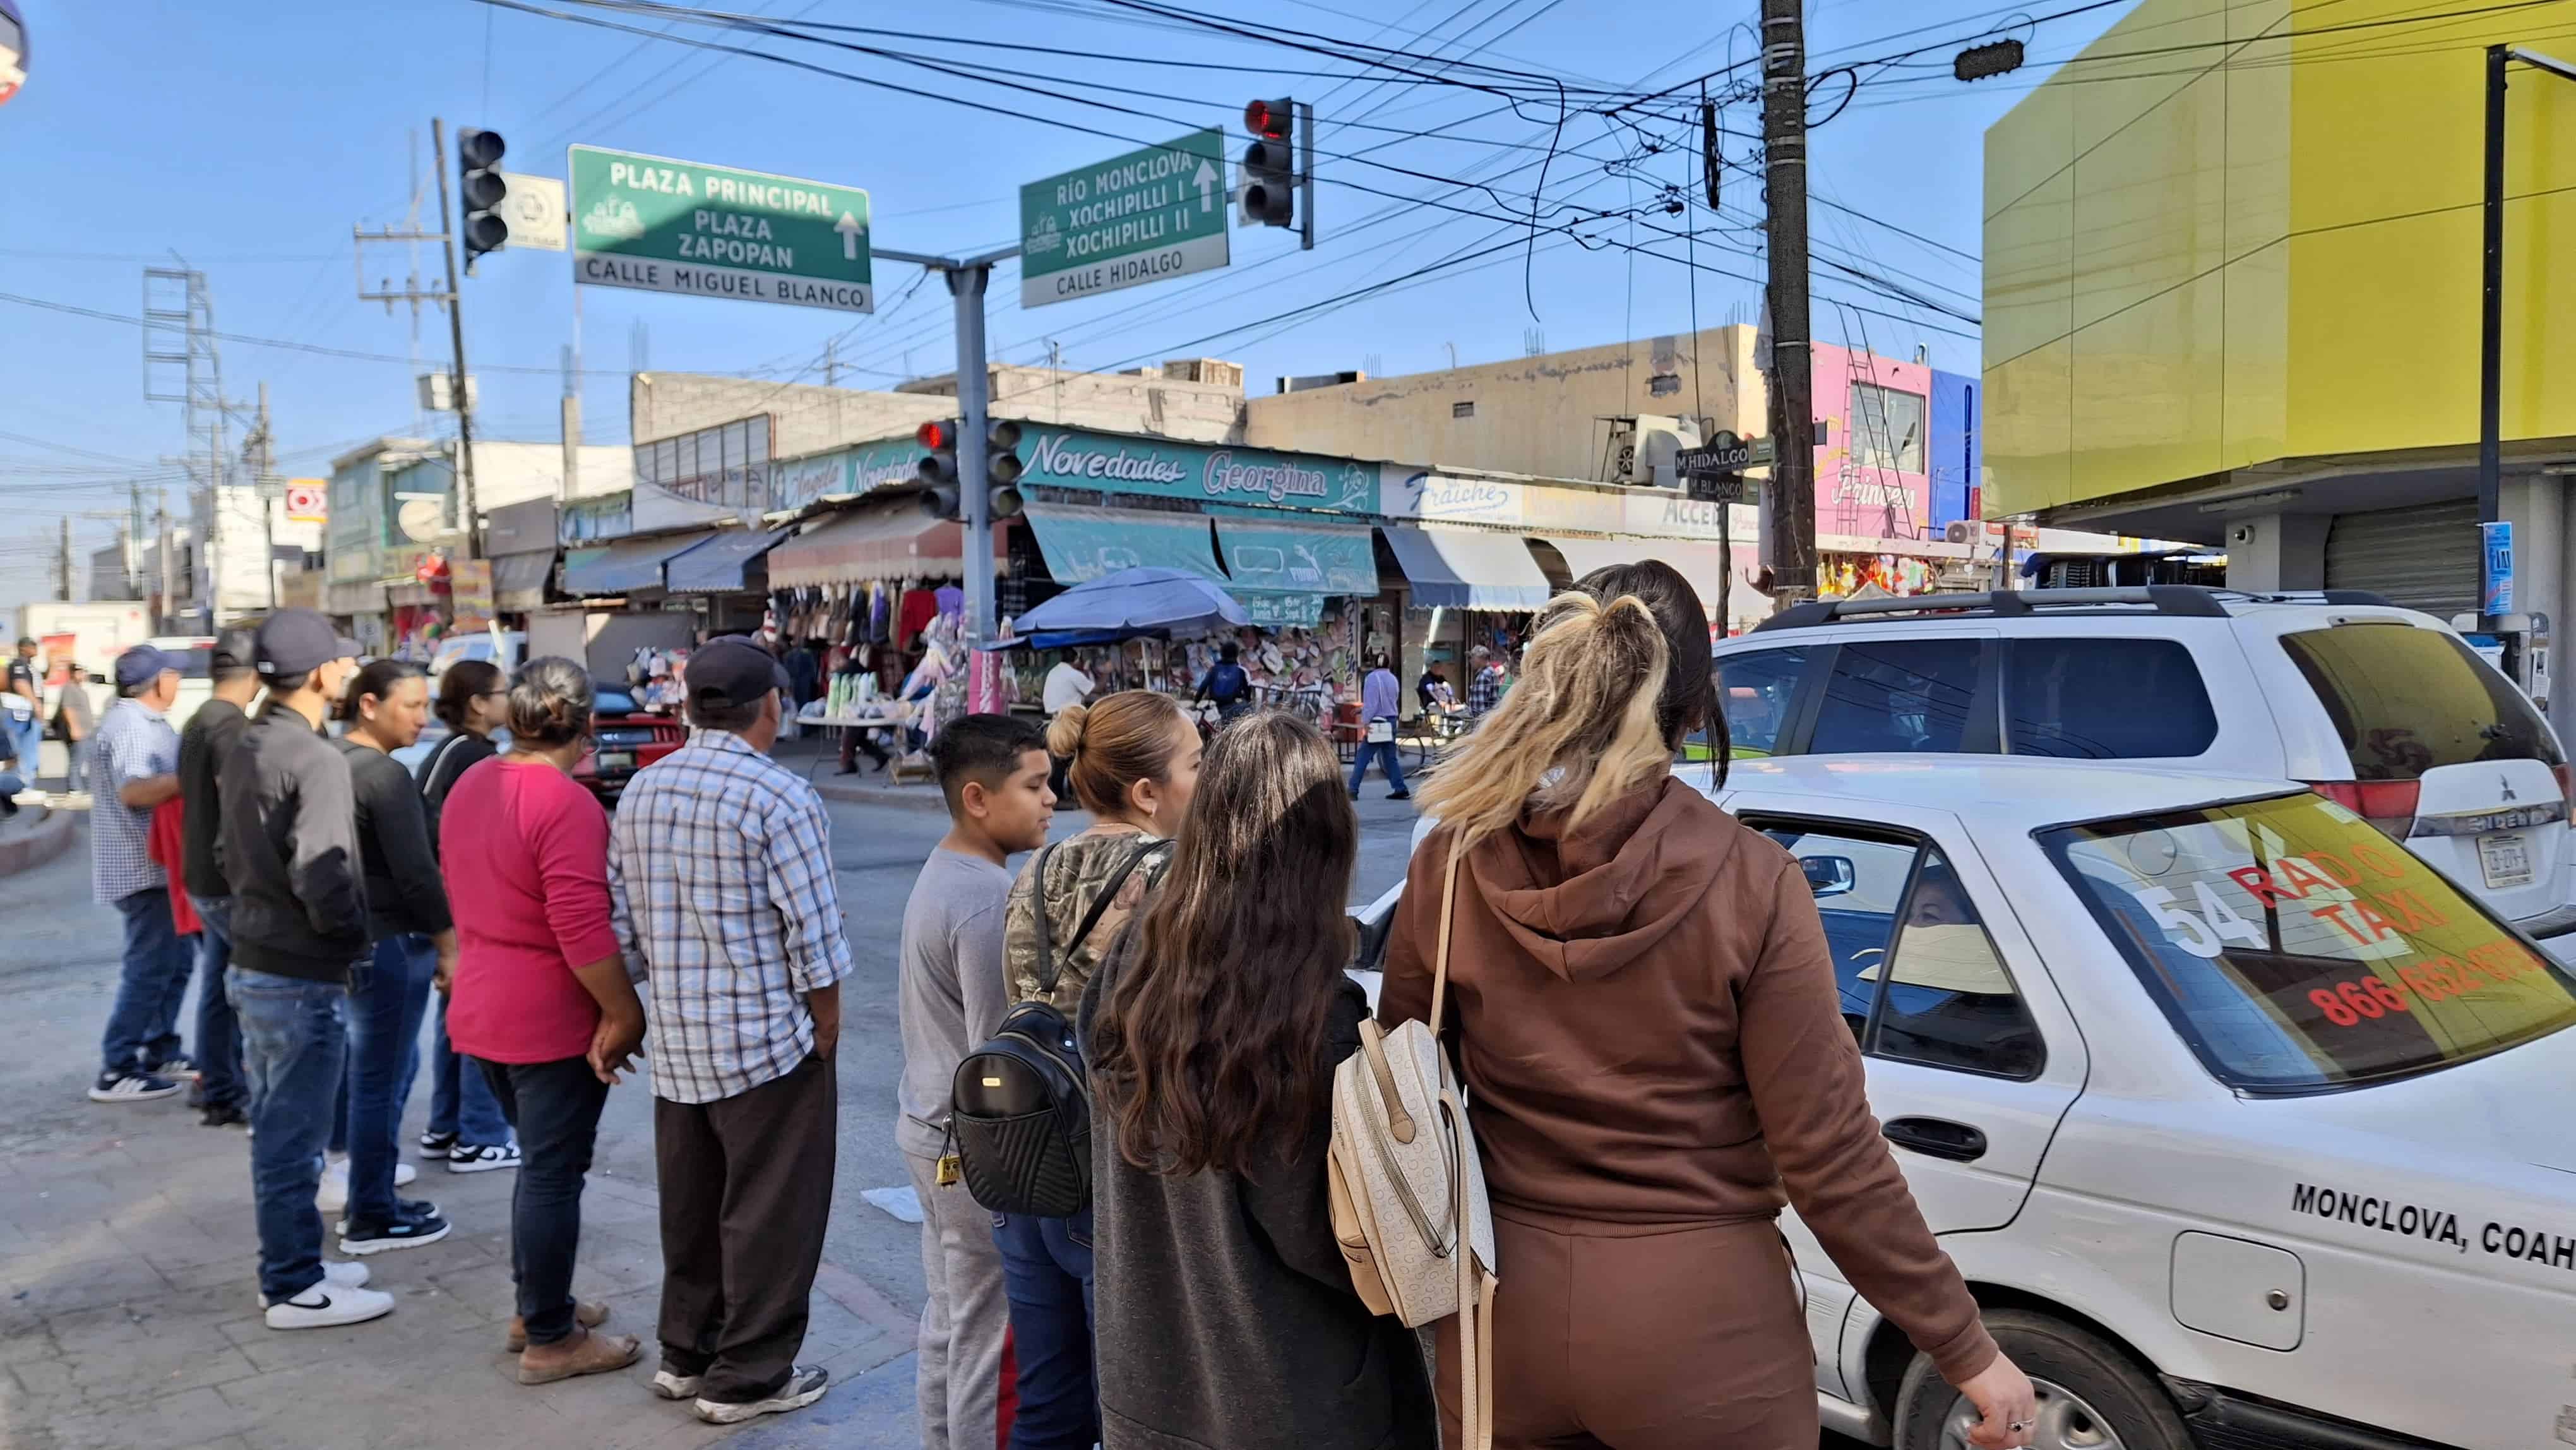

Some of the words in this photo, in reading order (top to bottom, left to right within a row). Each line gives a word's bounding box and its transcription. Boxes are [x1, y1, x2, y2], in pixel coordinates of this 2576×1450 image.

[611, 162, 693, 196] PLAZA
[705, 176, 833, 216] PRINCIPAL
[1057, 177, 1086, 207] RÍO
[1095, 151, 1192, 190] MONCLOVA
[695, 209, 772, 241] PLAZA
[1069, 184, 1167, 229] XOCHIPILLI
[1178, 180, 1184, 201] I
[678, 233, 792, 268] ZAPOPAN
[1066, 217, 1164, 258] XOCHIPILLI
[1176, 208, 1189, 232] II
[587, 259, 658, 285] CALLE
[675, 270, 765, 298] MIGUEL
[778, 282, 864, 307] BLANCO
[1056, 270, 1101, 295] CALLE
[1111, 251, 1183, 284] HIDALGO
[1021, 434, 1186, 482] Novedades
[1202, 450, 1327, 502] Georgina
[1832, 464, 1915, 510] Princess
[2134, 880, 2270, 958] 54
[2312, 888, 2449, 947] TAXI
[2293, 1183, 2469, 1253] MONCLOVA,
[2483, 1221, 2576, 1271] COAH
